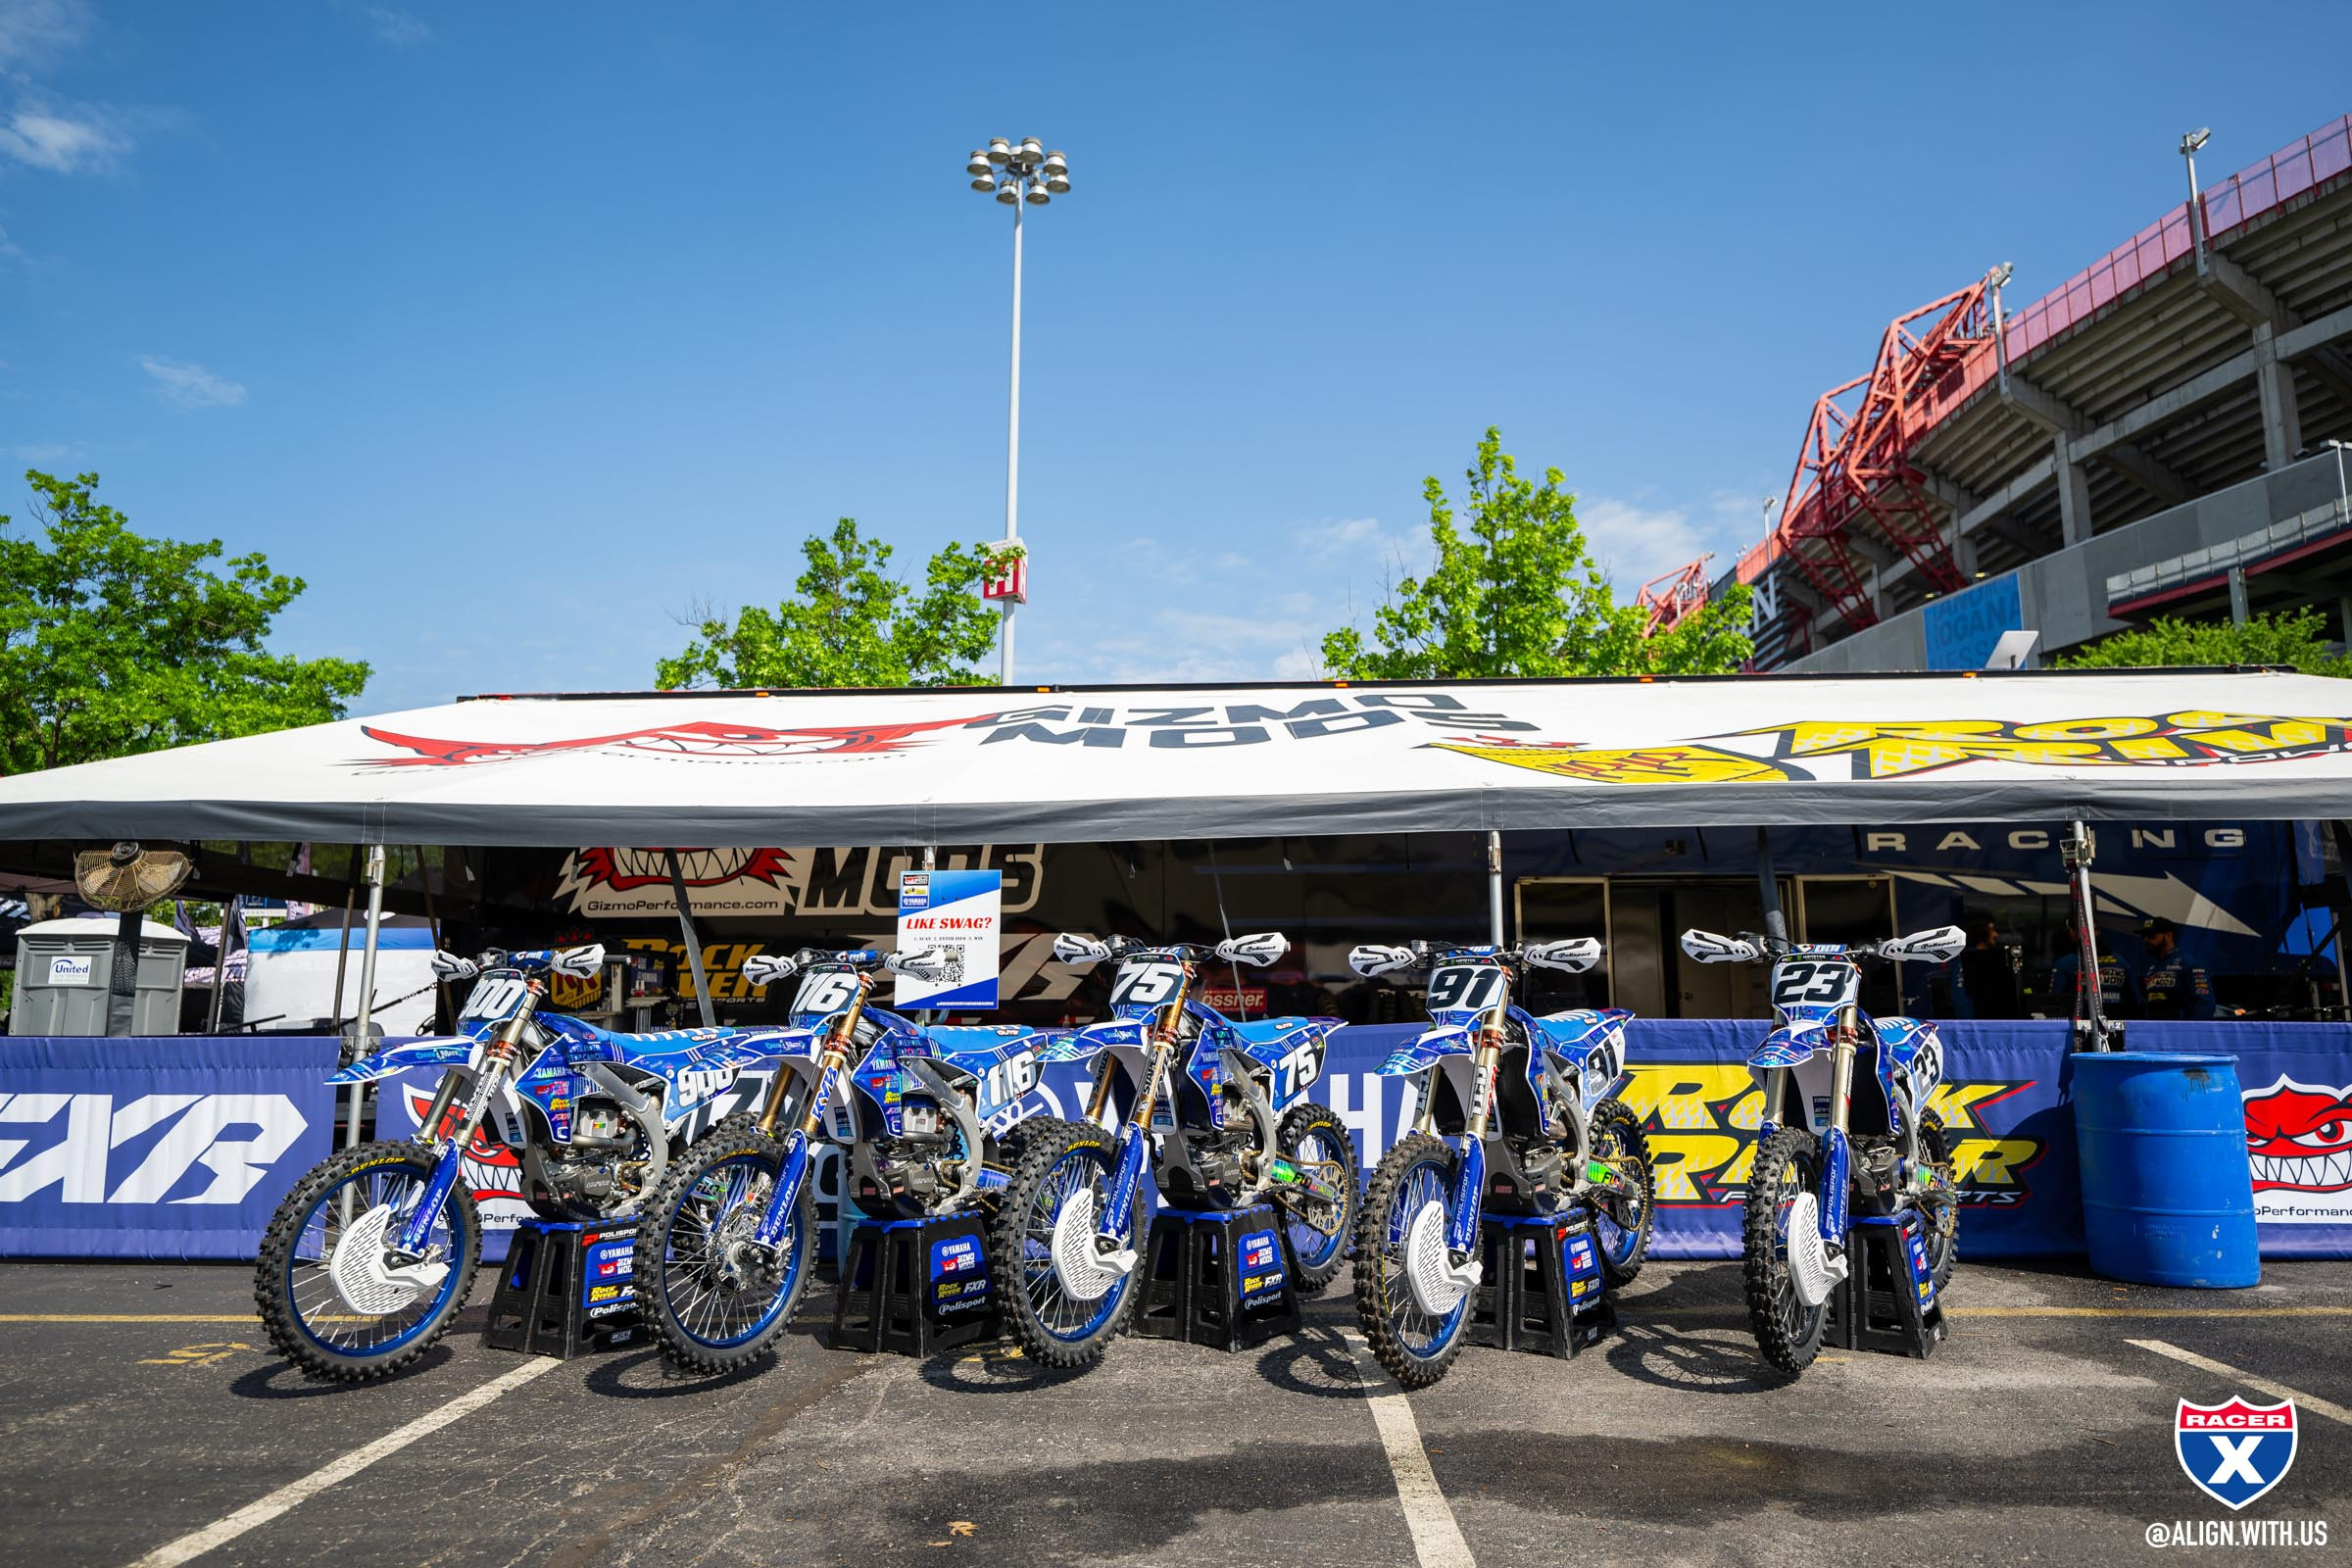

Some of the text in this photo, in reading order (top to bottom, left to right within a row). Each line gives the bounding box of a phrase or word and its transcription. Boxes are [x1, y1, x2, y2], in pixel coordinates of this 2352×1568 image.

[964, 694, 1469, 729] GIZMO
[980, 710, 1542, 748] MODS
[1867, 828, 2246, 853] RACNG
[587, 900, 778, 910] GizmoPerfomance.com
[906, 916, 992, 929] LIKE SWAG?
[55, 964, 89, 974] United
[1113, 962, 1178, 1004] 75
[1774, 963, 1854, 1004] 23
[795, 972, 857, 1013] 116
[1428, 968, 1501, 1008] 91
[536, 1066, 566, 1078] YAMAHA
[871, 1059, 897, 1070] YAMAHA
[987, 1051, 1037, 1107] 116
[1279, 1041, 1317, 1098] 75
[1587, 1037, 1618, 1097] 91
[1913, 1043, 1940, 1100] 23
[677, 1067, 733, 1107] 900
[1064, 1139, 1102, 1153] DUNLOP
[348, 1156, 406, 1176] DUNLOP
[1117, 1173, 1135, 1229] DUNLOP
[1456, 1168, 1470, 1221] POLISPORT
[1828, 1160, 1837, 1215] POLISPORT
[770, 1181, 796, 1238] DUNLOP
[1464, 1186, 1479, 1242] DUNLOP
[599, 1227, 637, 1239] POLISPO
[948, 1243, 971, 1254] YAMAHA
[963, 1279, 986, 1294] FXR
[1264, 1274, 1283, 1288] FXR
[590, 1301, 639, 1318] Polispo
[939, 1296, 986, 1315] Polisport
[1245, 1291, 1282, 1310] Polisport
